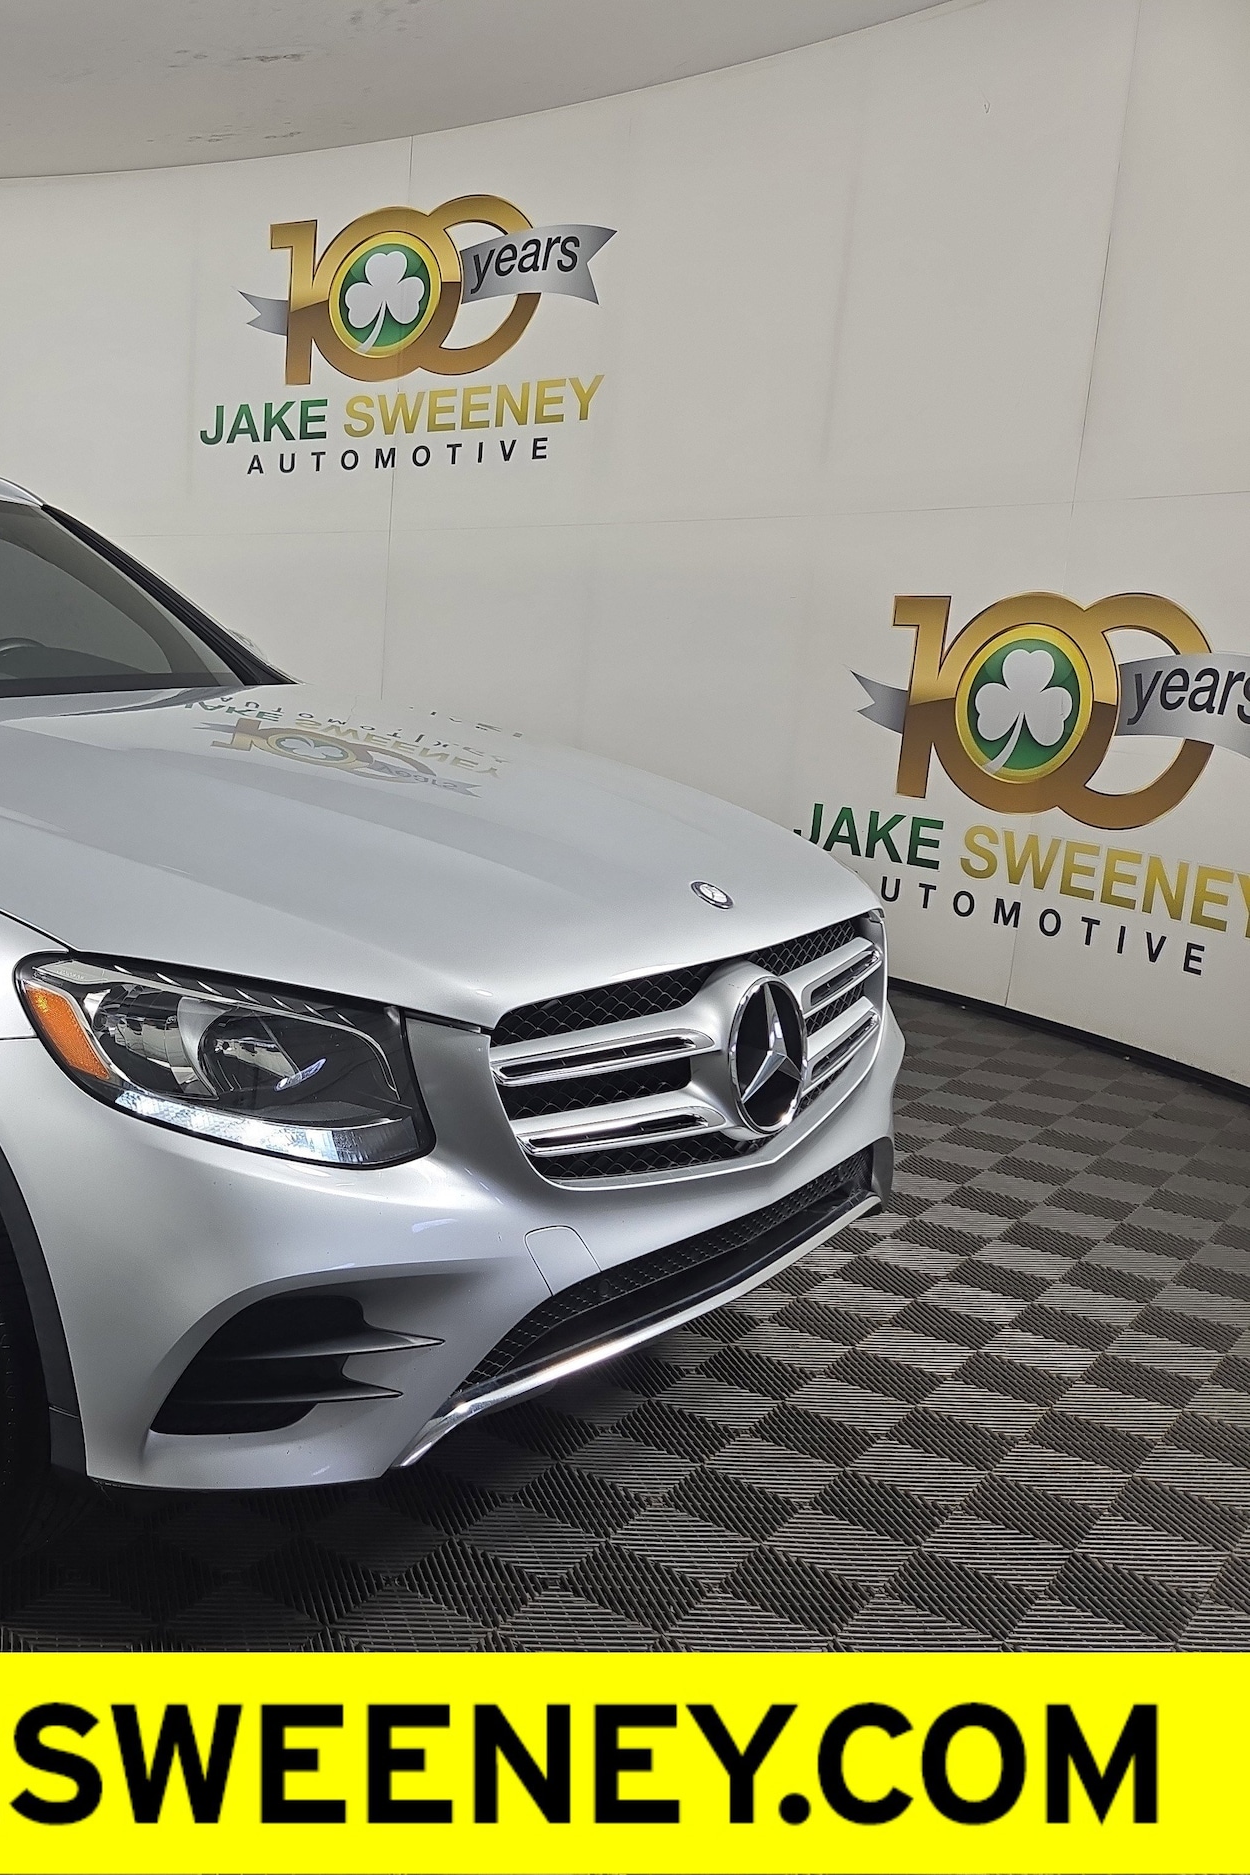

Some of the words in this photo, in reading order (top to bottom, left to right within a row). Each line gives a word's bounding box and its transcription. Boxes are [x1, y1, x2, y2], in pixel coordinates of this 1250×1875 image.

[270, 194, 542, 385] 100
[470, 235, 580, 294] years
[200, 398, 328, 445] JAKE
[344, 374, 605, 437] SWEENEY
[247, 437, 549, 475] AUTOMOTIVE
[893, 591, 1214, 831] 100
[793, 803, 944, 870] JAKE
[880, 876, 1206, 976] UTOMOTIVE
